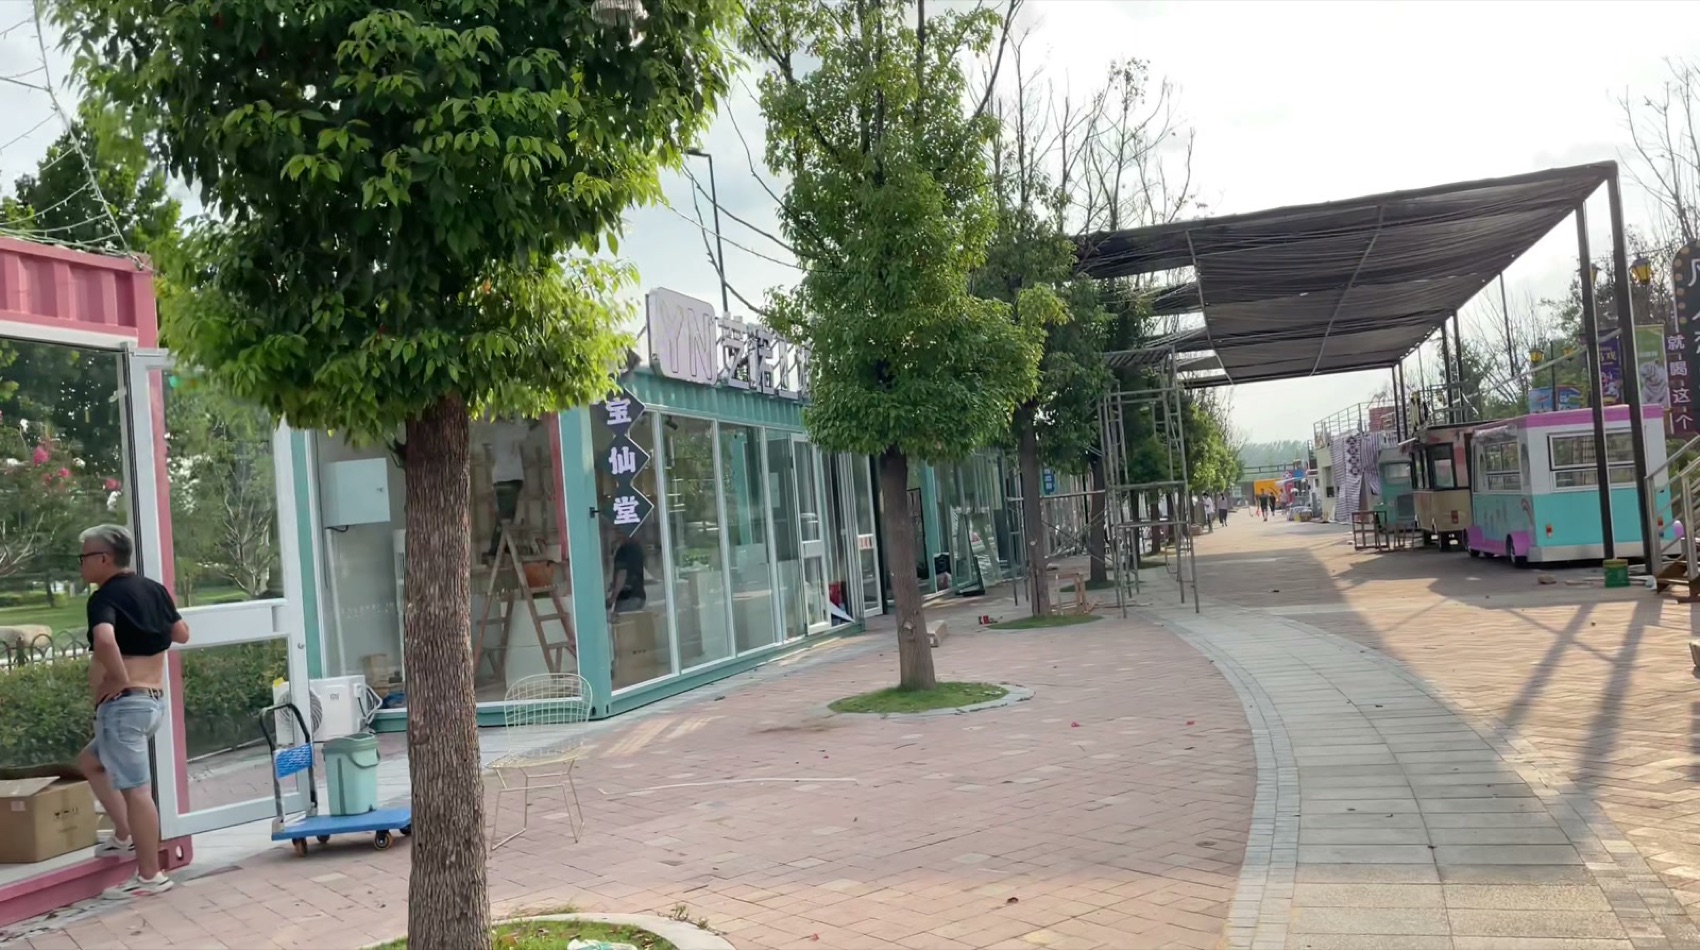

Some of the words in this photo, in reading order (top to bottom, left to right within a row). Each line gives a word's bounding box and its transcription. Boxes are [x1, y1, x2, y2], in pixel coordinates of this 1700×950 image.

[660, 301, 714, 381] YN
[1667, 335, 1693, 430] 就喝这个
[605, 397, 641, 525] 宝仙堂
